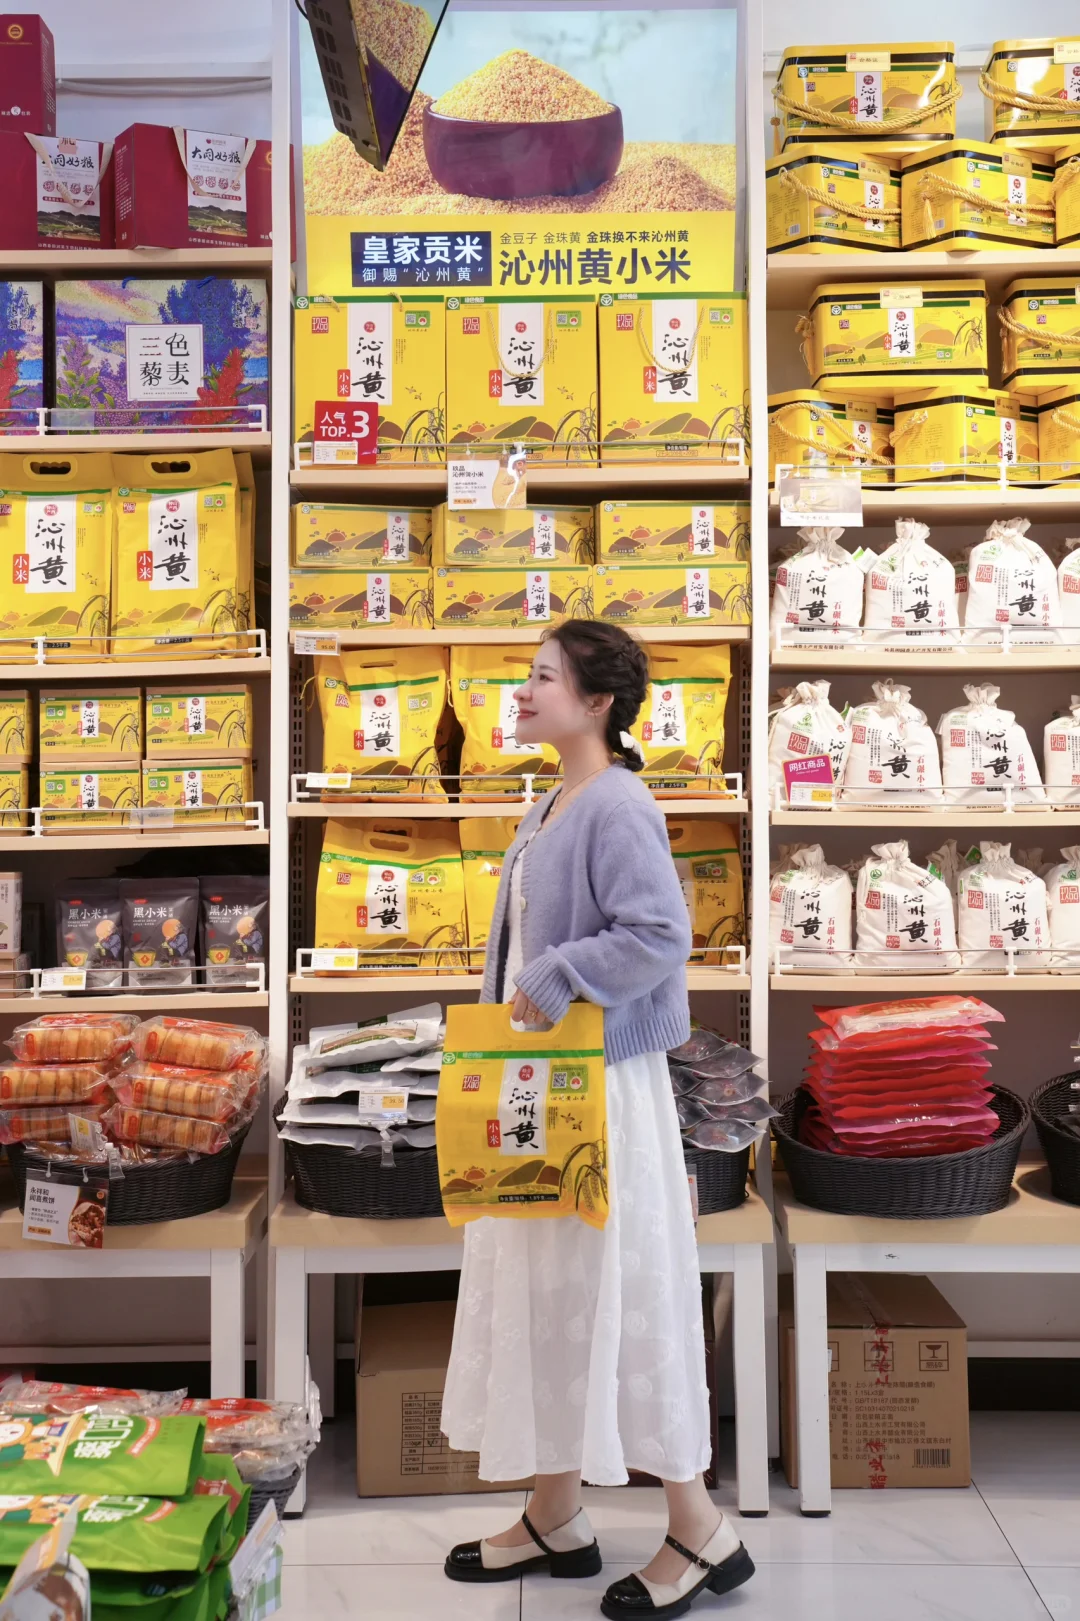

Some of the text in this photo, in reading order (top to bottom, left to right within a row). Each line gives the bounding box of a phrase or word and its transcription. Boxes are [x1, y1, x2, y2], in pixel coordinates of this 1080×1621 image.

[850, 99, 858, 114] 小米
[860, 86, 878, 118] 沁州黄
[42, 154, 95, 169] 同好粮
[362, 235, 483, 265] 皇家贡米
[500, 230, 689, 245] 金豆子 金珠黄 金珠换不来沁州黄
[499, 248, 692, 286] 沁州黄小米
[617, 314, 632, 328] 玖品
[139, 332, 190, 357] 三色
[893, 322, 910, 354] 沁州黄
[351, 337, 386, 399] 沁州黄
[503, 337, 538, 399] 沁州黄
[645, 369, 656, 391] 小米
[658, 334, 692, 396] 沁州黄
[339, 372, 349, 395] 小米
[490, 373, 501, 395] 小米
[320, 410, 370, 439] TOP. 3
[321, 411, 346, 424] 人气
[153, 515, 190, 582] 沁州黄
[390, 525, 406, 558] 沁州黄
[536, 523, 552, 556] 沁州黄
[694, 520, 711, 552] 沁州黄
[30, 519, 68, 585] 沁州黄
[139, 552, 153, 580] 小米
[14, 555, 28, 582] 小米
[369, 587, 386, 619] 沁州黄
[529, 585, 547, 617] 沁州黄
[689, 582, 706, 614] 沁州黄
[799, 570, 828, 623] 沁州黄
[904, 572, 932, 623] 沁州黄
[1008, 569, 1037, 617] 沁州黄
[83, 710, 96, 736] 沁州黄
[189, 707, 203, 734] 沁州黄
[364, 712, 394, 752] 沁州黄
[643, 723, 652, 739] 小米
[653, 701, 680, 741] 沁州黄
[355, 731, 364, 748] 小米
[493, 729, 502, 746] 小米
[789, 759, 826, 773] 网红商品
[983, 729, 1012, 778] 沁州黄
[370, 885, 401, 929] 沁州黄
[1060, 886, 1080, 903] 玖品
[68, 908, 102, 920] 黑小米
[133, 907, 167, 918] 黑小米
[209, 904, 243, 916] 黑小米
[358, 908, 367, 926] 小米
[794, 890, 822, 940] 沁州黄
[899, 895, 928, 942] 沁州黄
[1001, 891, 1030, 941] 沁州黄
[463, 1075, 480, 1091] 玖品
[488, 1122, 499, 1145] 小米
[503, 1088, 539, 1149] 沁州黄
